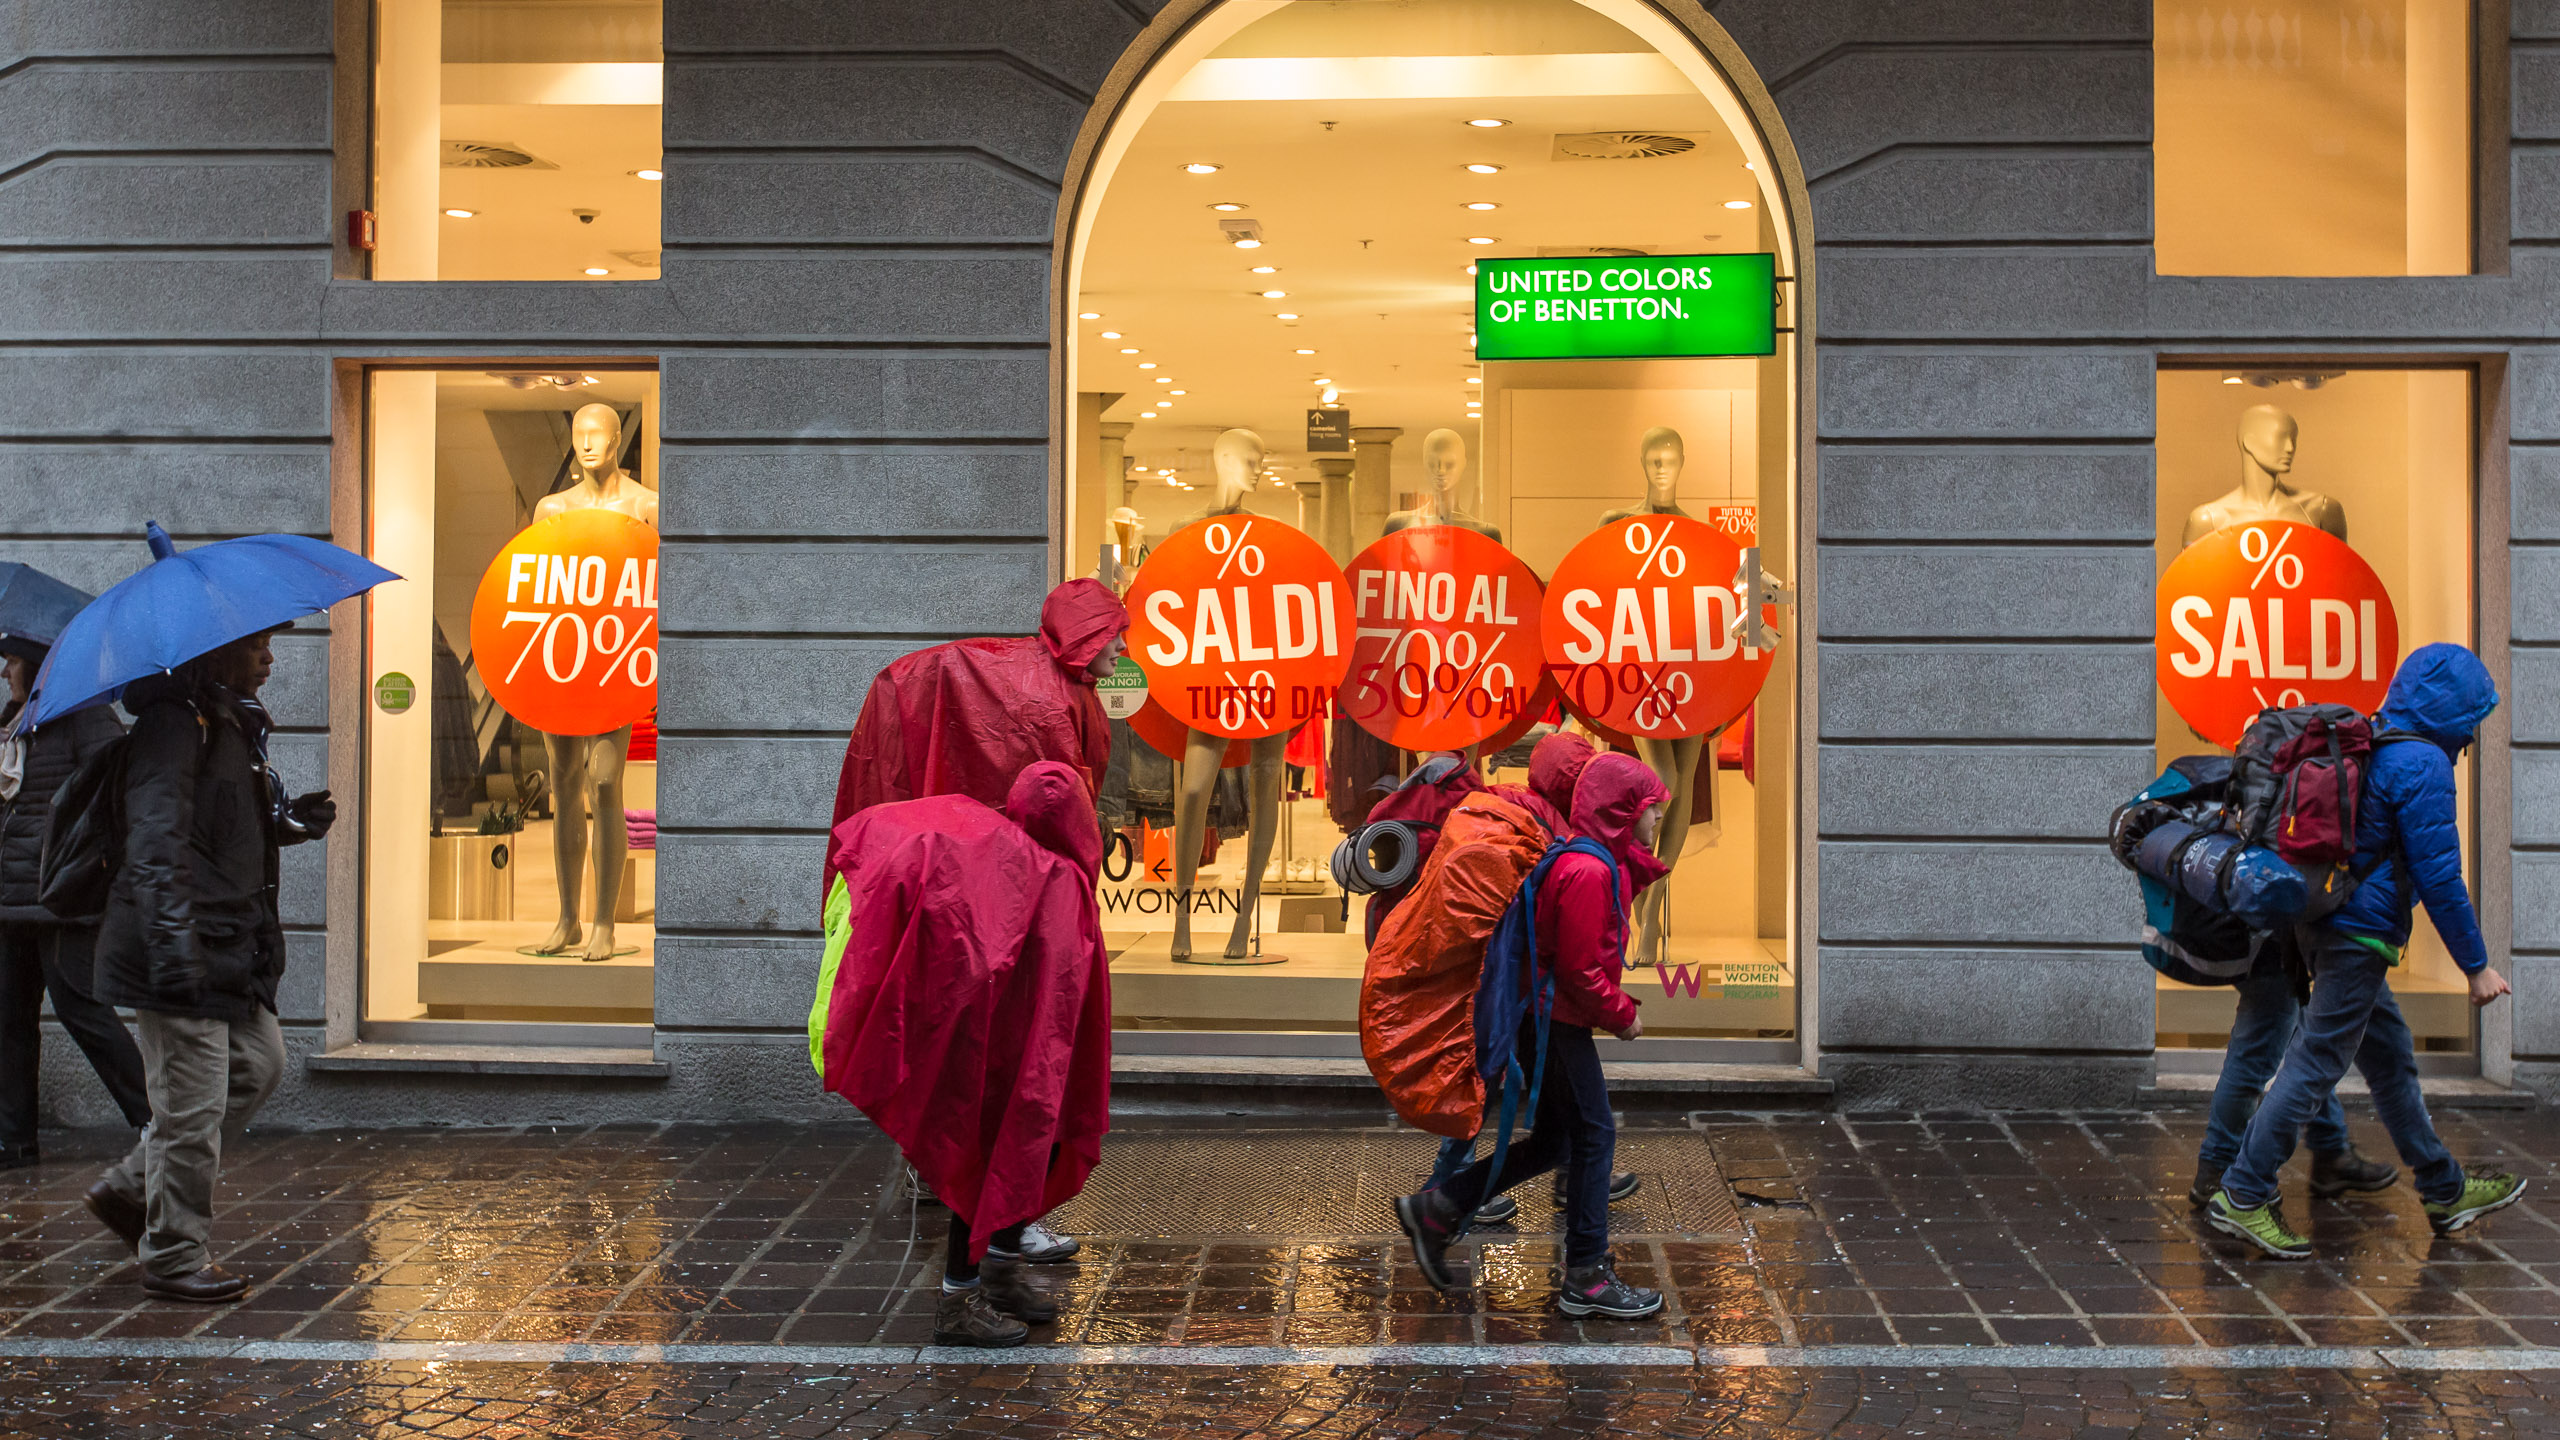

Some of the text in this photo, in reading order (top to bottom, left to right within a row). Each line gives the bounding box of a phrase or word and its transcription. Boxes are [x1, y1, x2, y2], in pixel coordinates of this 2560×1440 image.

[1489, 267, 1713, 293] UNITED COLORS
[1489, 297, 1690, 323] OF BENETTON.
[1715, 516, 1756, 535] 70%
[1720, 507, 1753, 516] TUTTO AL
[1204, 520, 1265, 580] %
[1625, 520, 1686, 580] %
[2239, 526, 2304, 590] %
[506, 553, 659, 608] FINO AL
[1356, 569, 1518, 625] FINO AL
[1145, 581, 1339, 667] SALDI
[2170, 595, 2378, 681] SALDI
[501, 610, 658, 688] 70%
[1356, 626, 1515, 703] 70%
[1117, 677, 1143, 687] NOI?
[1186, 661, 1678, 721] TUTTO DAL 50% AL 70%
[1101, 888, 1241, 914] WOMAN
[1655, 963, 1724, 998] WE
[1724, 963, 1779, 972] BENETTON
[1725, 972, 1779, 983] WOMEN
[1724, 990, 1779, 999] PROGRAM
